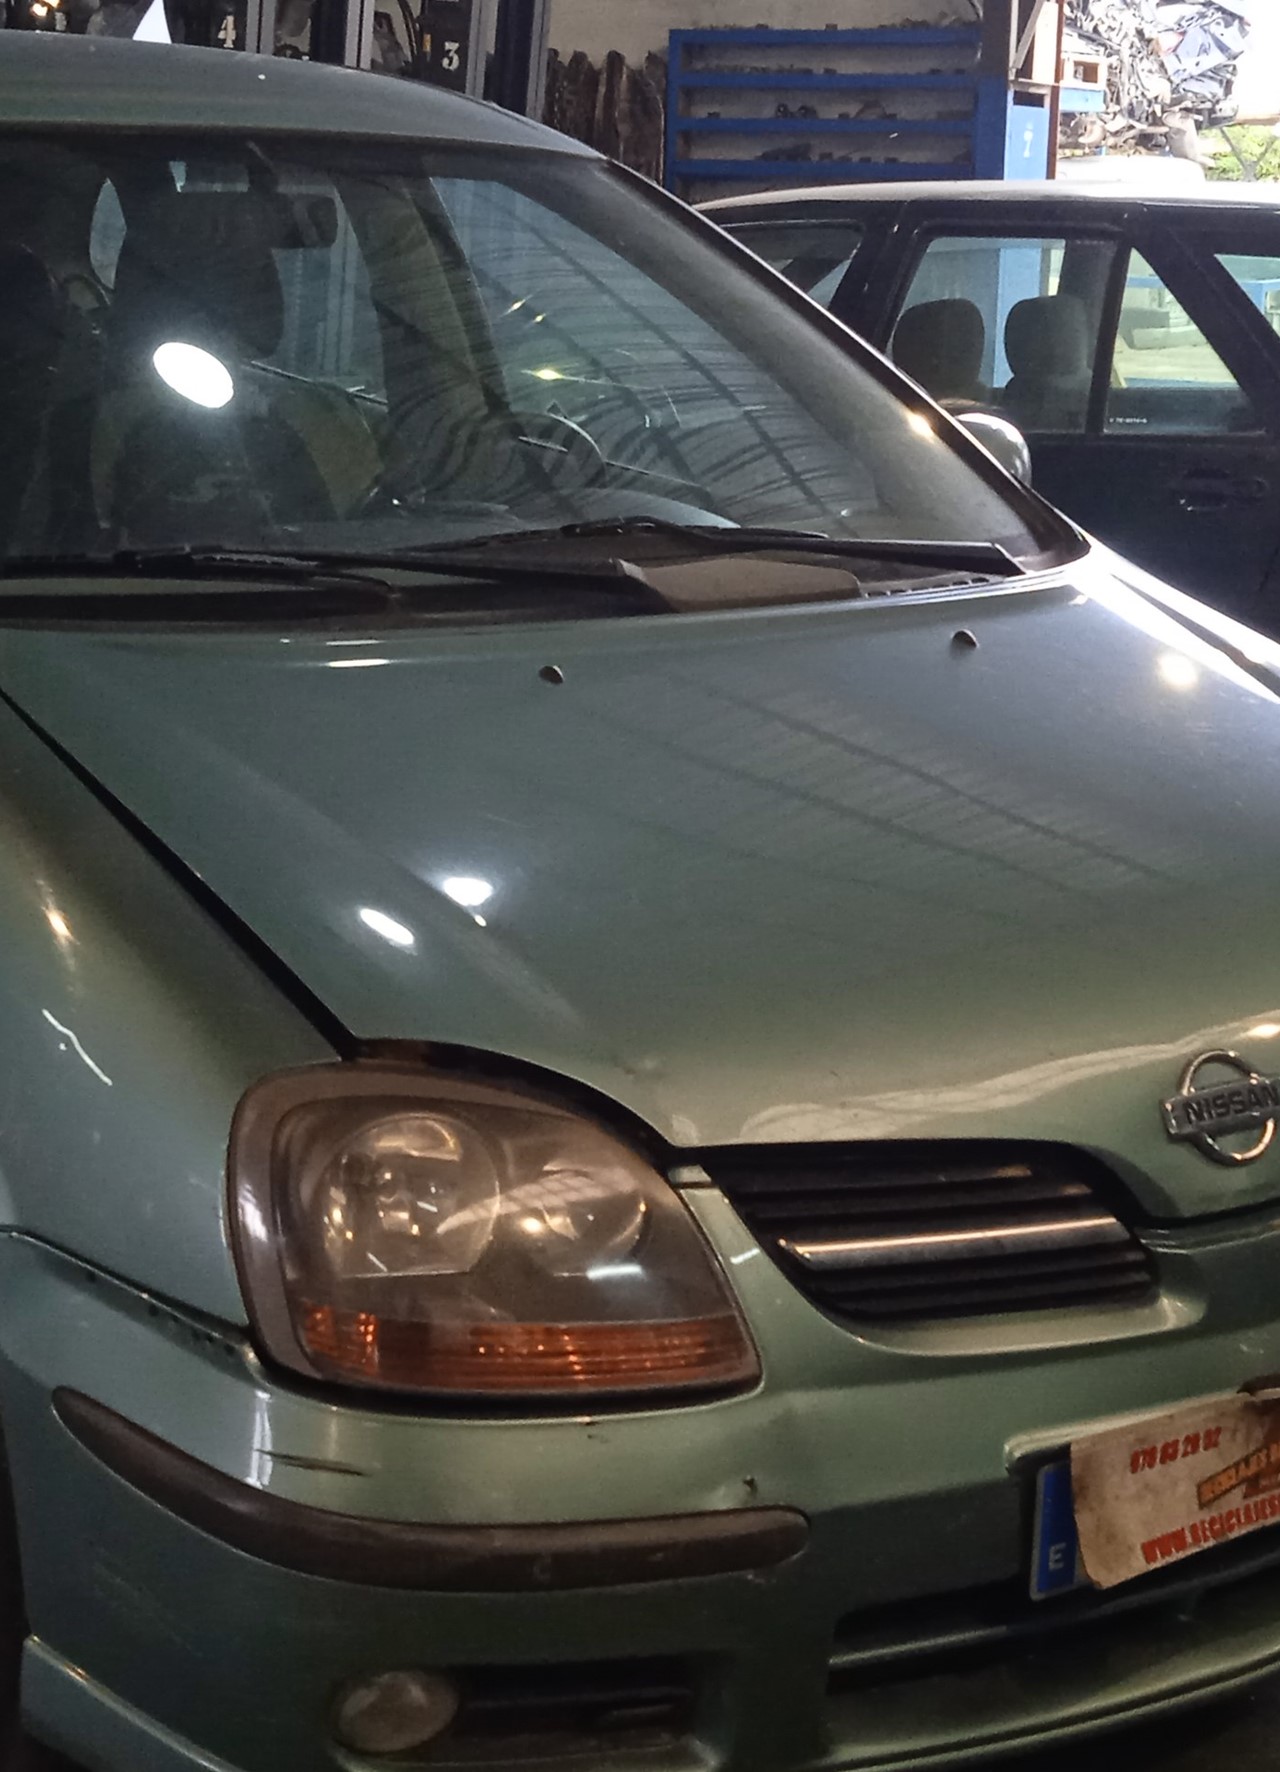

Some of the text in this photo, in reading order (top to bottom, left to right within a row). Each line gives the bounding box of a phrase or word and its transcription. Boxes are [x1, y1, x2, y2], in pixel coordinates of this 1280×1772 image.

[217, 12, 236, 48] 4
[442, 41, 460, 71] 3
[1182, 1084, 1280, 1125] NISSAN
[1048, 1542, 1066, 1571] E
